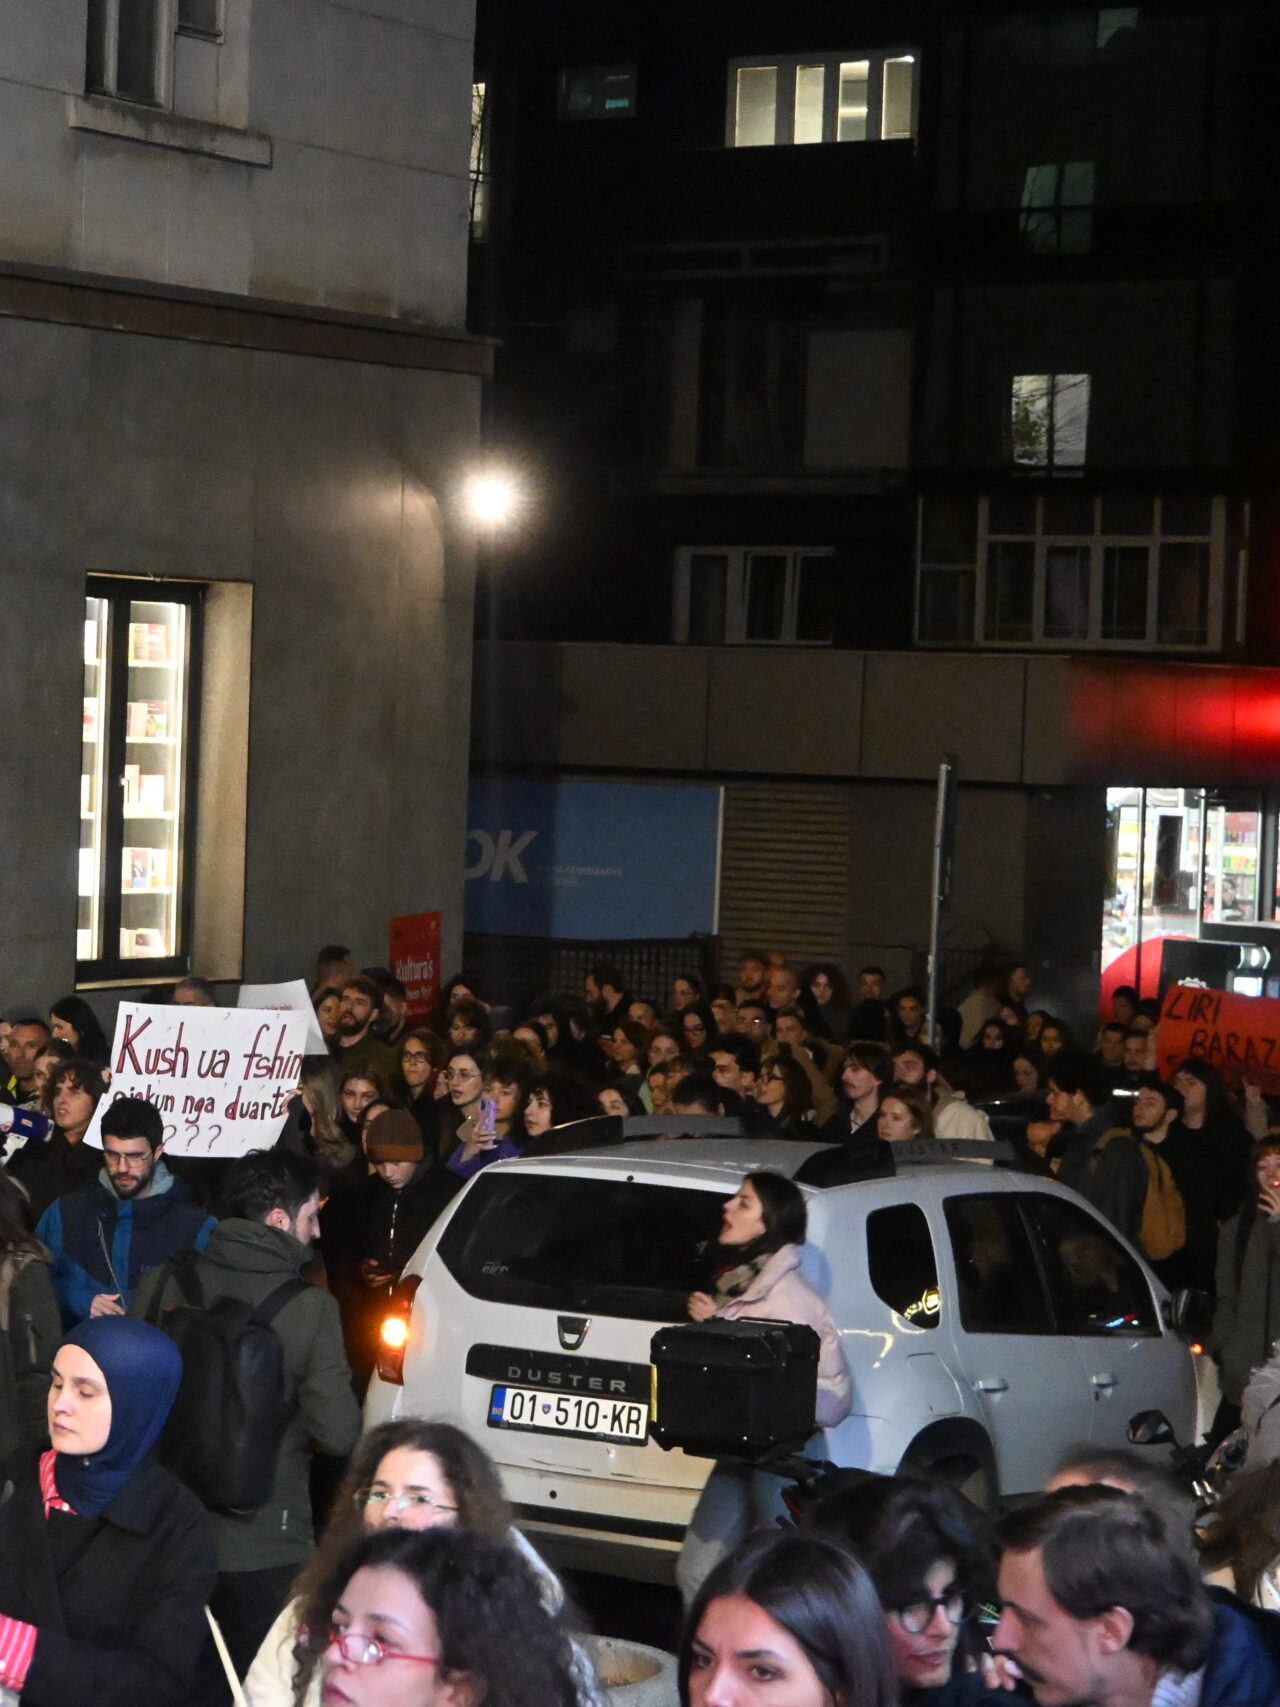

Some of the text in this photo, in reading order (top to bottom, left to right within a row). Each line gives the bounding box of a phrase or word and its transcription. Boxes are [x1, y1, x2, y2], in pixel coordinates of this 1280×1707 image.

[1166, 992, 1222, 1025] LIRI
[115, 1014, 189, 1078] Kush
[197, 1049, 230, 1078] ua
[181, 1096, 216, 1124] nga
[225, 1085, 284, 1120] duart
[508, 1366, 626, 1393] DUSTER
[510, 1392, 642, 1435] 01 510-KR
